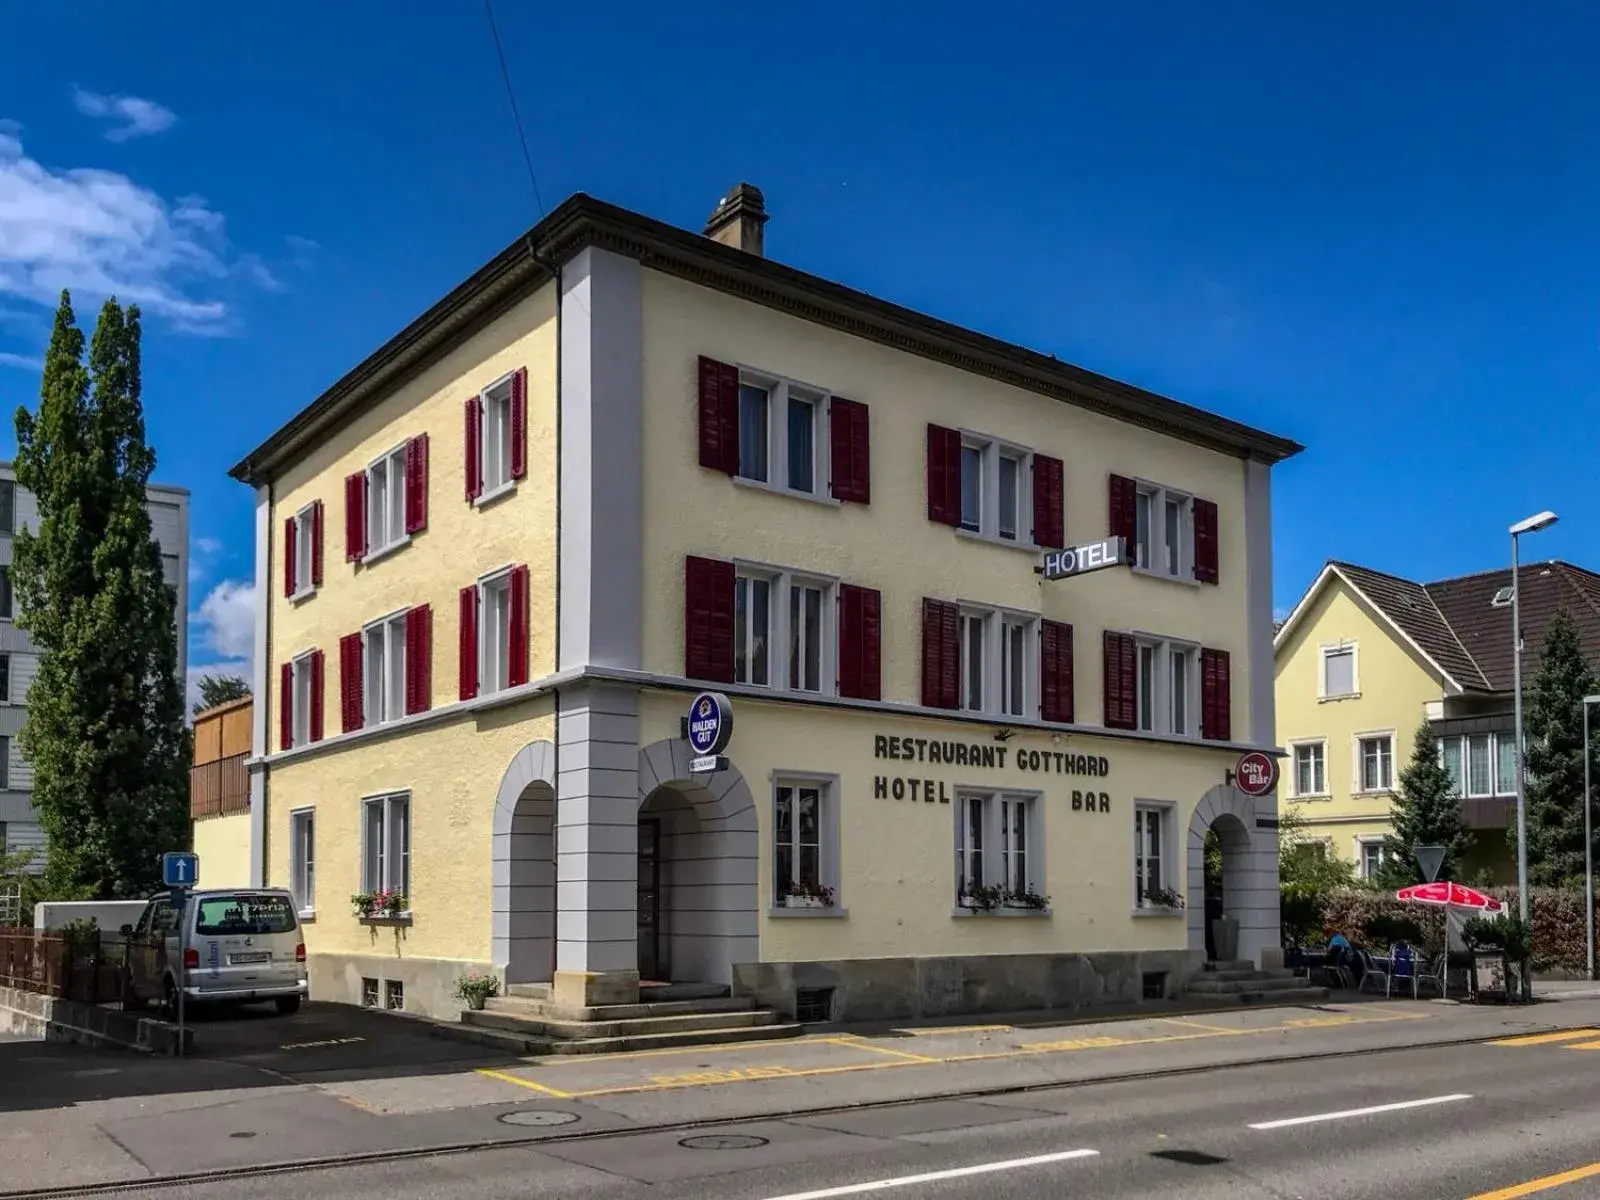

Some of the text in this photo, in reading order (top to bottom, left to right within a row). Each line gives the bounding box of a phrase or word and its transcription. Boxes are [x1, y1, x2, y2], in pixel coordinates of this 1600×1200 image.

[1046, 542, 1117, 576] HOTEL
[698, 731, 711, 743] GUT
[875, 735, 1109, 777] RESTAURANT GOTTHARD
[1242, 763, 1264, 775] City
[1249, 774, 1268, 784] Bar
[874, 776, 950, 803] HOTEL
[1072, 790, 1111, 813] BAR
